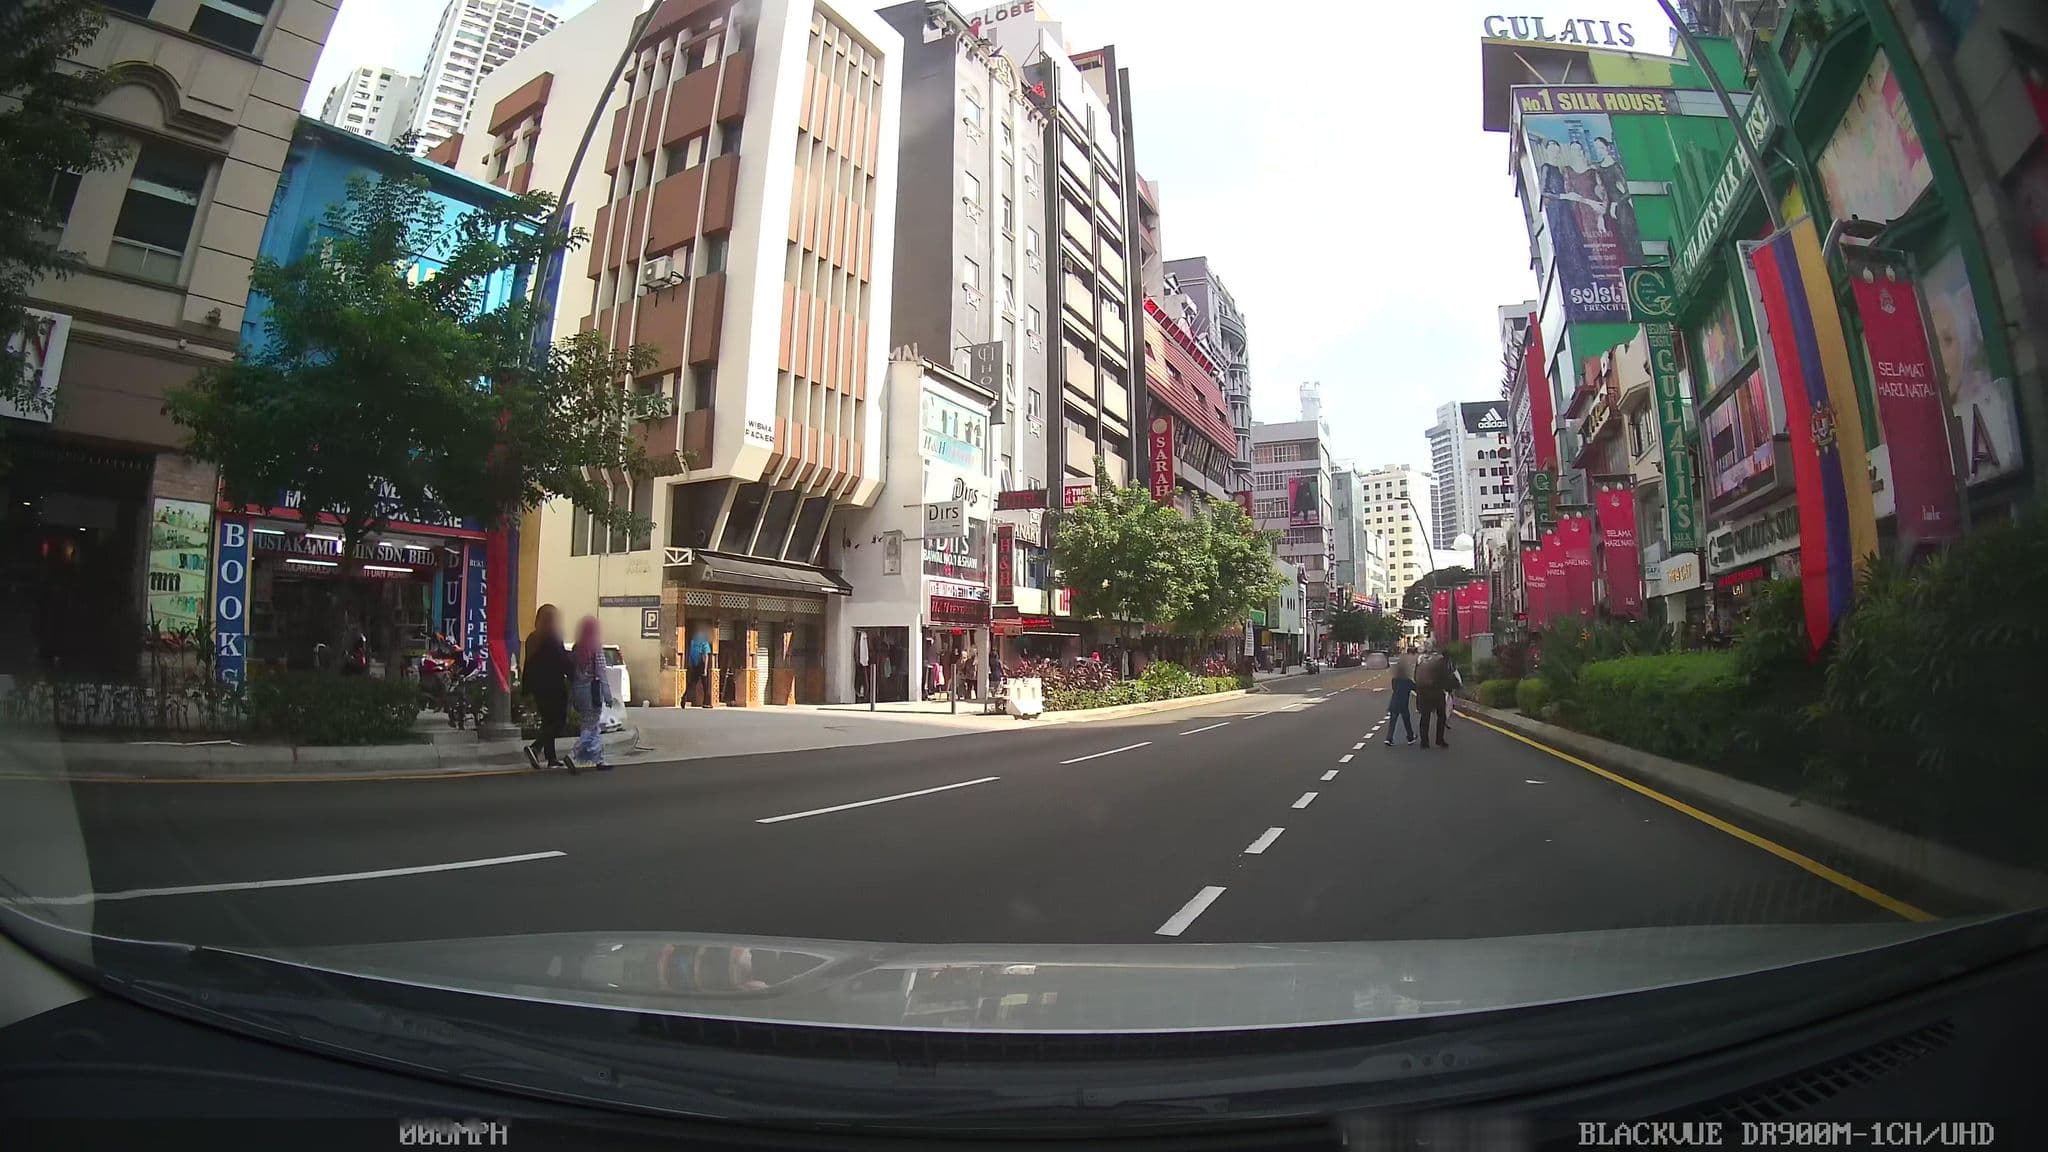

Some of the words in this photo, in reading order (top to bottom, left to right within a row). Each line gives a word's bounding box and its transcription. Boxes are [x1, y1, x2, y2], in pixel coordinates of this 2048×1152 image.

[1483, 15, 1636, 48] GULATIS
[1521, 88, 1554, 112] No.1
[1556, 93, 1603, 111] SILK
[1602, 93, 1668, 112] HOUSE
[1714, 157, 1740, 217] SILK
[1734, 94, 1770, 177] HUSE
[1570, 282, 1628, 305] solsti
[1878, 361, 1925, 378] SELAMAT
[1878, 382, 1905, 397] HARI
[1904, 383, 1936, 398] NATAL
[747, 419, 772, 433] WISMA
[1656, 349, 1692, 530] GULATI'S
[928, 504, 960, 522] Dirs
[377, 545, 406, 564] SDN.
[408, 548, 438, 566] BHD.
